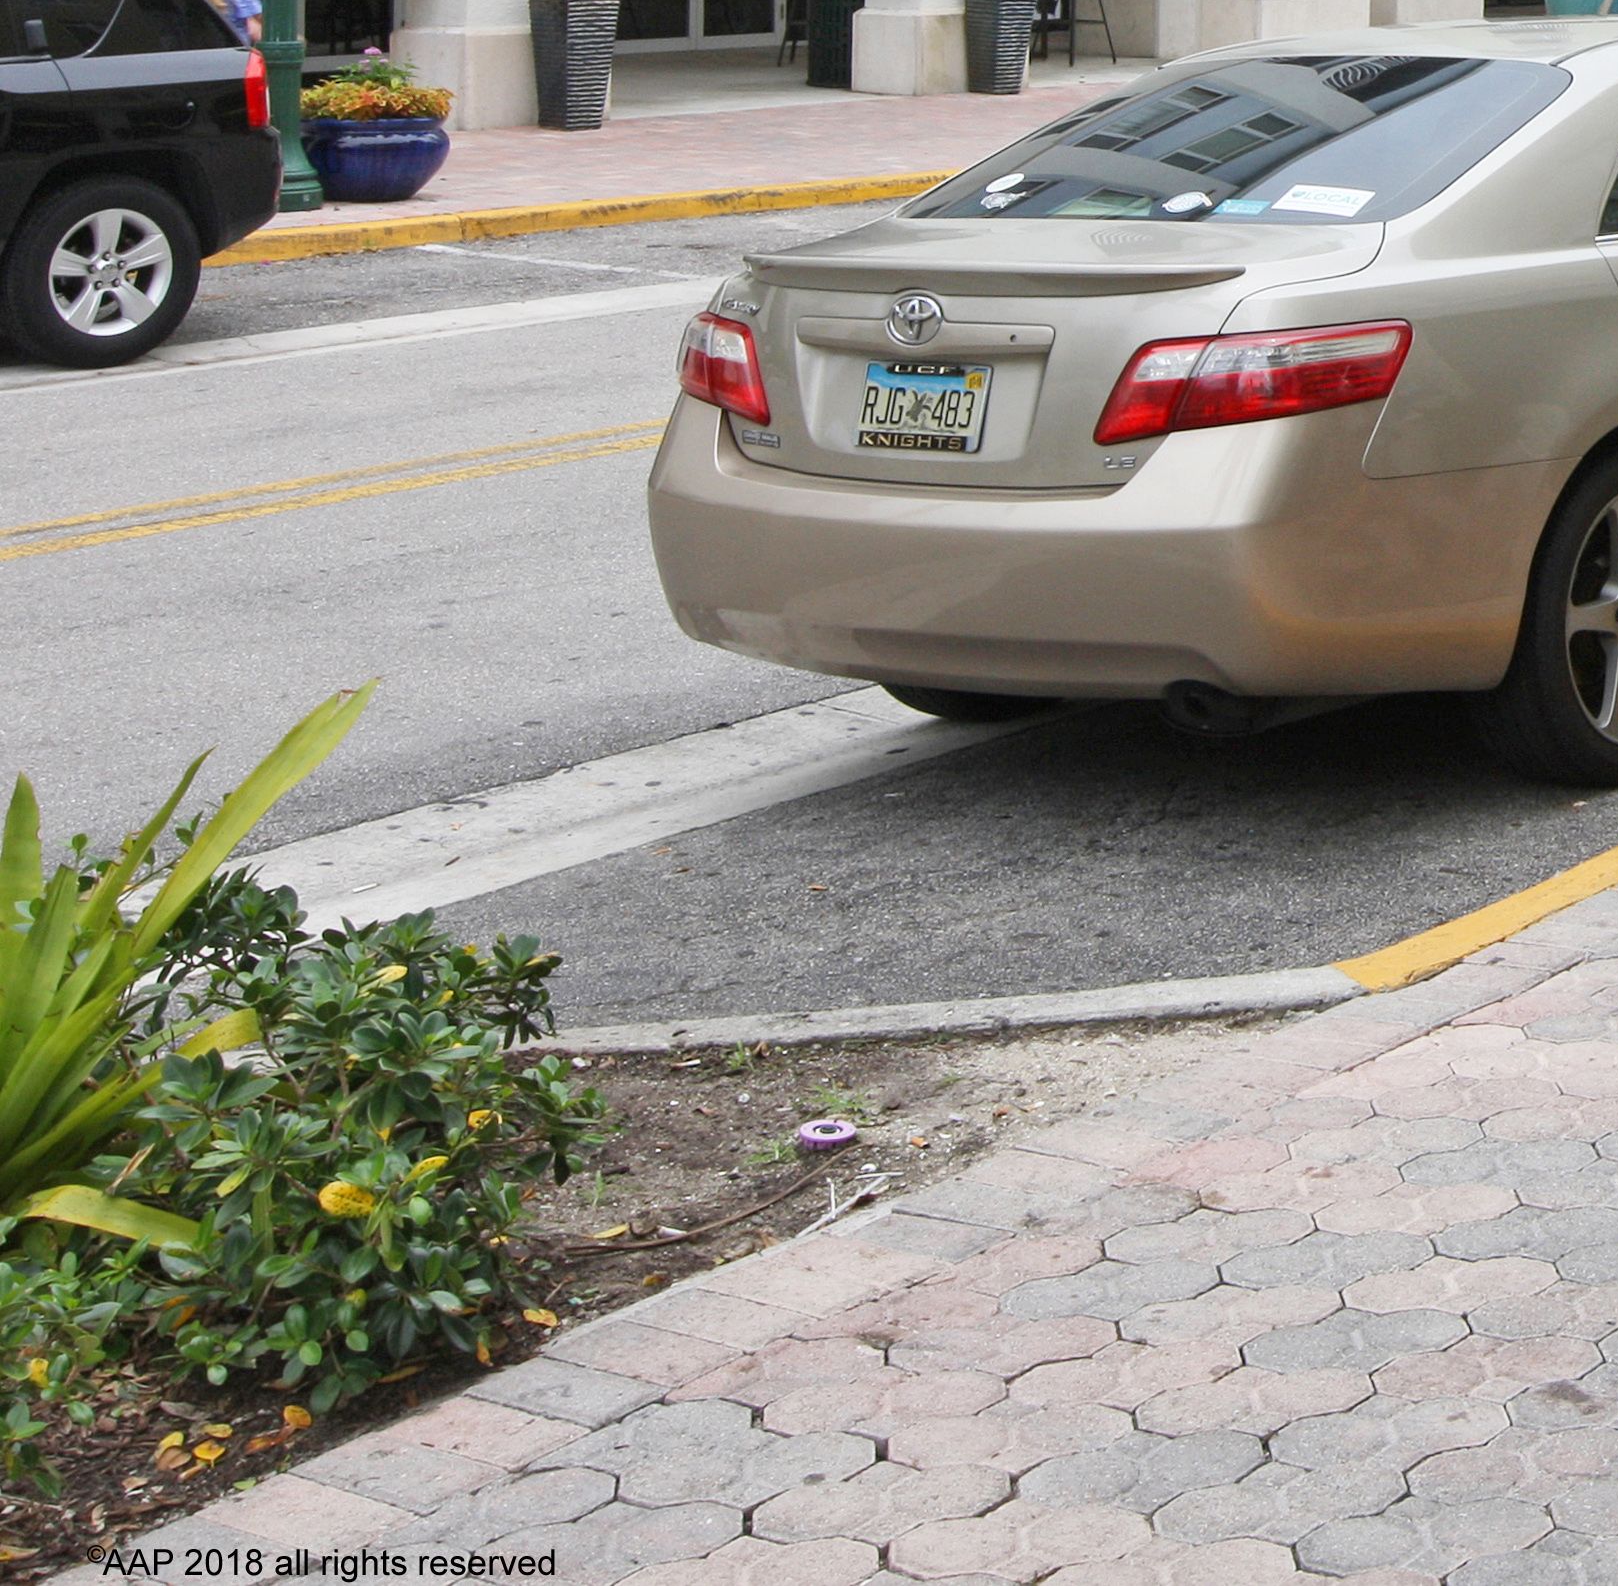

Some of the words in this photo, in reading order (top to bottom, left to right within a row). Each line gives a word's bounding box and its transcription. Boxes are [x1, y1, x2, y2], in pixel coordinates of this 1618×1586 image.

[1304, 190, 1361, 207] LOCAL
[893, 364, 958, 375] UCF
[861, 432, 963, 451] KNIGHTS
[1103, 456, 1137, 469] LE
